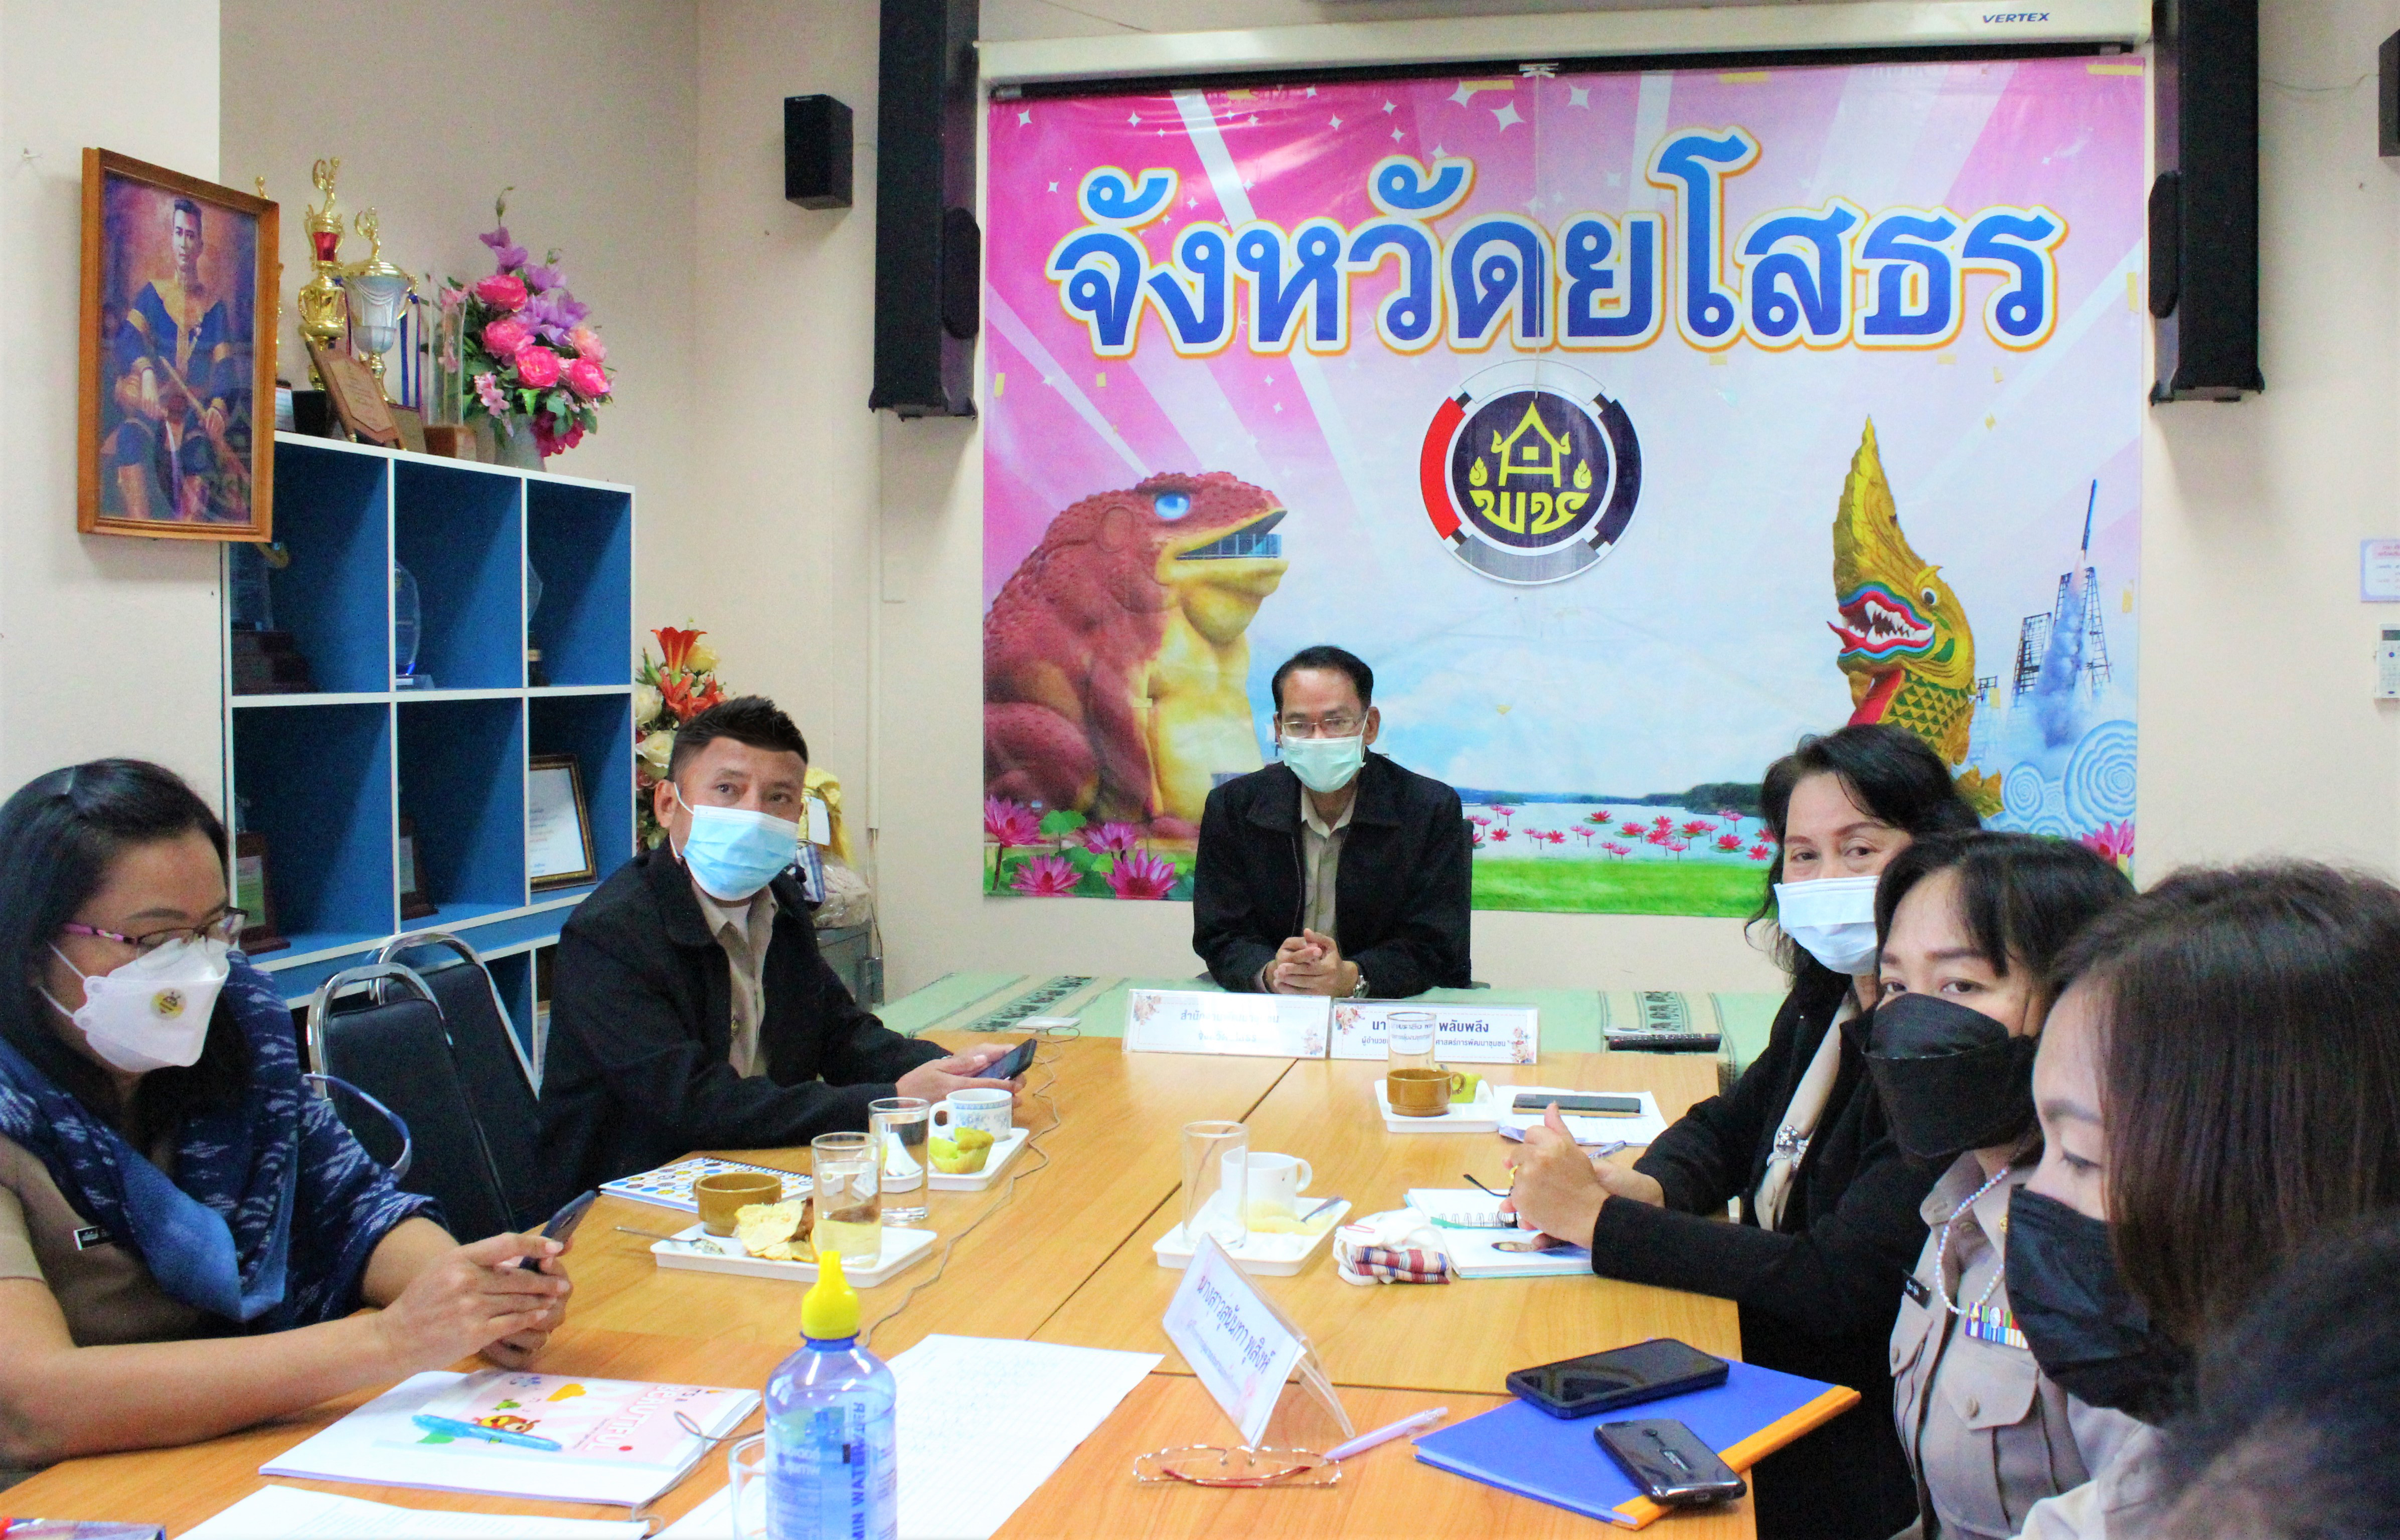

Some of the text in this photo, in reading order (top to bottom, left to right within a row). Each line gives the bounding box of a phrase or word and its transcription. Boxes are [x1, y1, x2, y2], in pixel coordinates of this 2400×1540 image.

[1983, 13, 2050, 23] VERTEX
[1050, 130, 2061, 353] จังหวัดยโสธร
[1439, 1019, 1489, 1033] พลับพลึง
